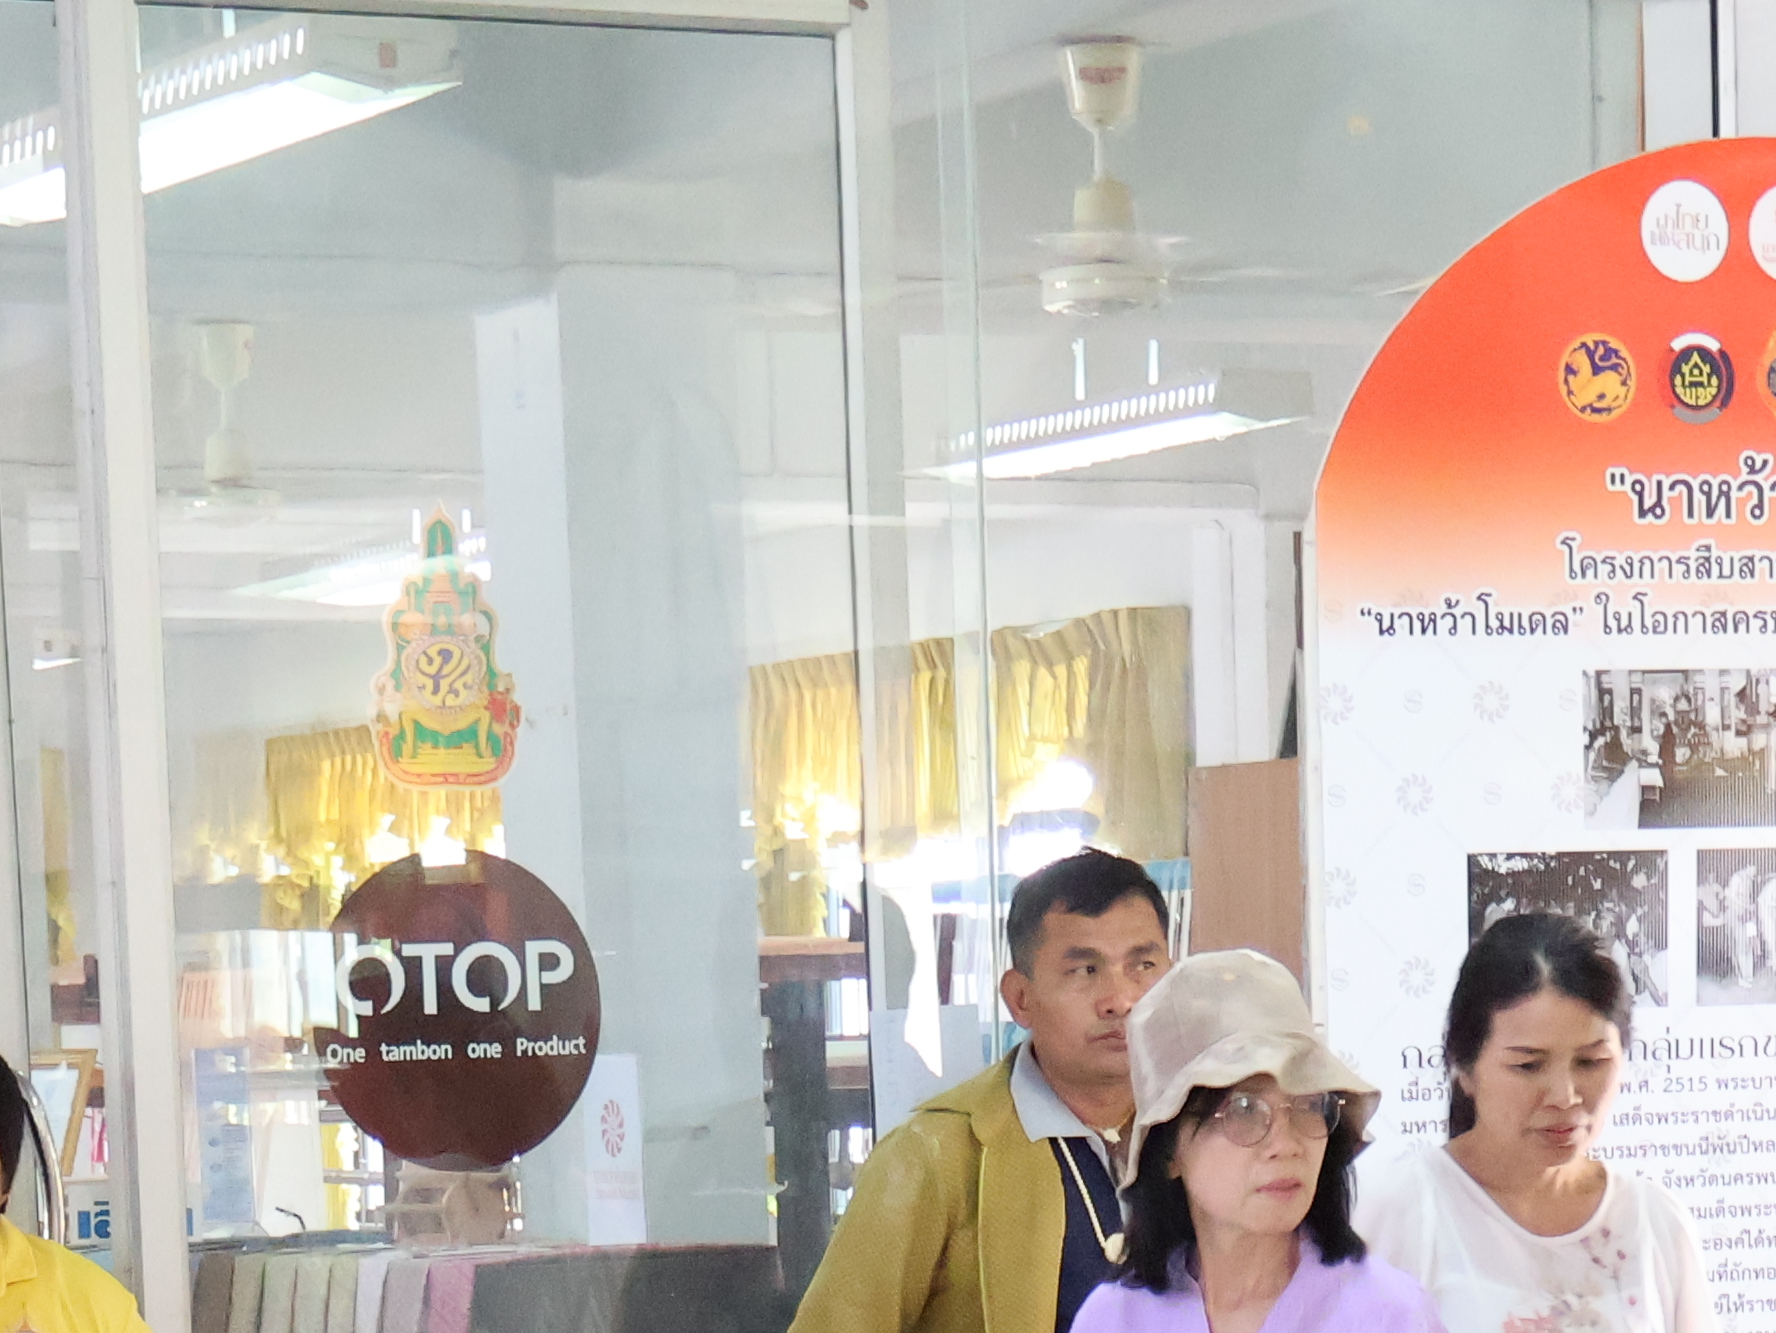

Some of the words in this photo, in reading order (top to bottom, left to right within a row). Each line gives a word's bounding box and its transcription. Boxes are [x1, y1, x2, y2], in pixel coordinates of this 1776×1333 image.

[335, 939, 575, 1018] OTOP
[326, 1040, 367, 1064] One
[379, 1038, 453, 1062] tambon
[466, 1039, 502, 1059] one
[516, 1034, 587, 1058] Product
[1661, 1075, 1709, 1094] 2515
